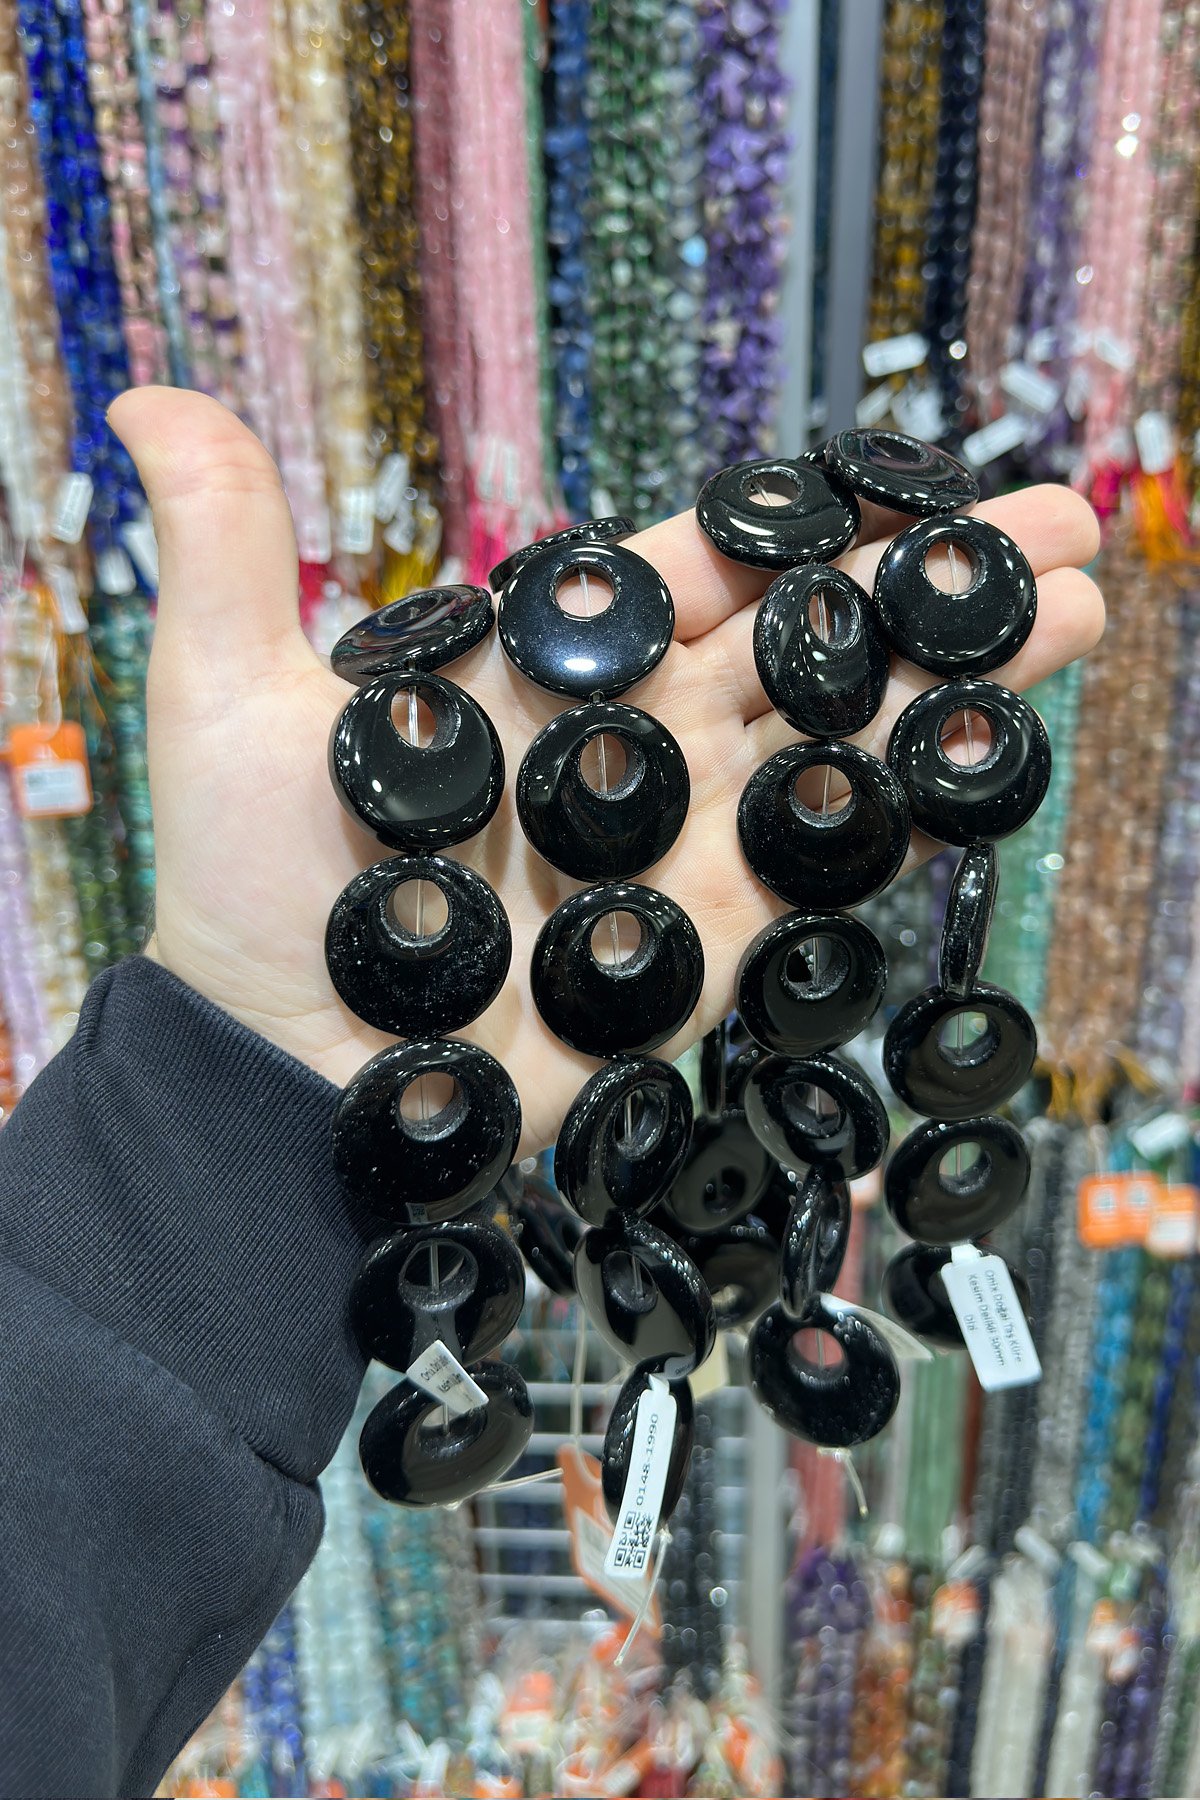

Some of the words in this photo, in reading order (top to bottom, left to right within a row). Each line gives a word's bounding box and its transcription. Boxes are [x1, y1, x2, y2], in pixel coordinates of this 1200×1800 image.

[967, 1274, 983, 1303] Kesim
[984, 1269, 999, 1292] Onix
[993, 1295, 1010, 1322] Doğal
[636, 1413, 658, 1506] 0148-1990
